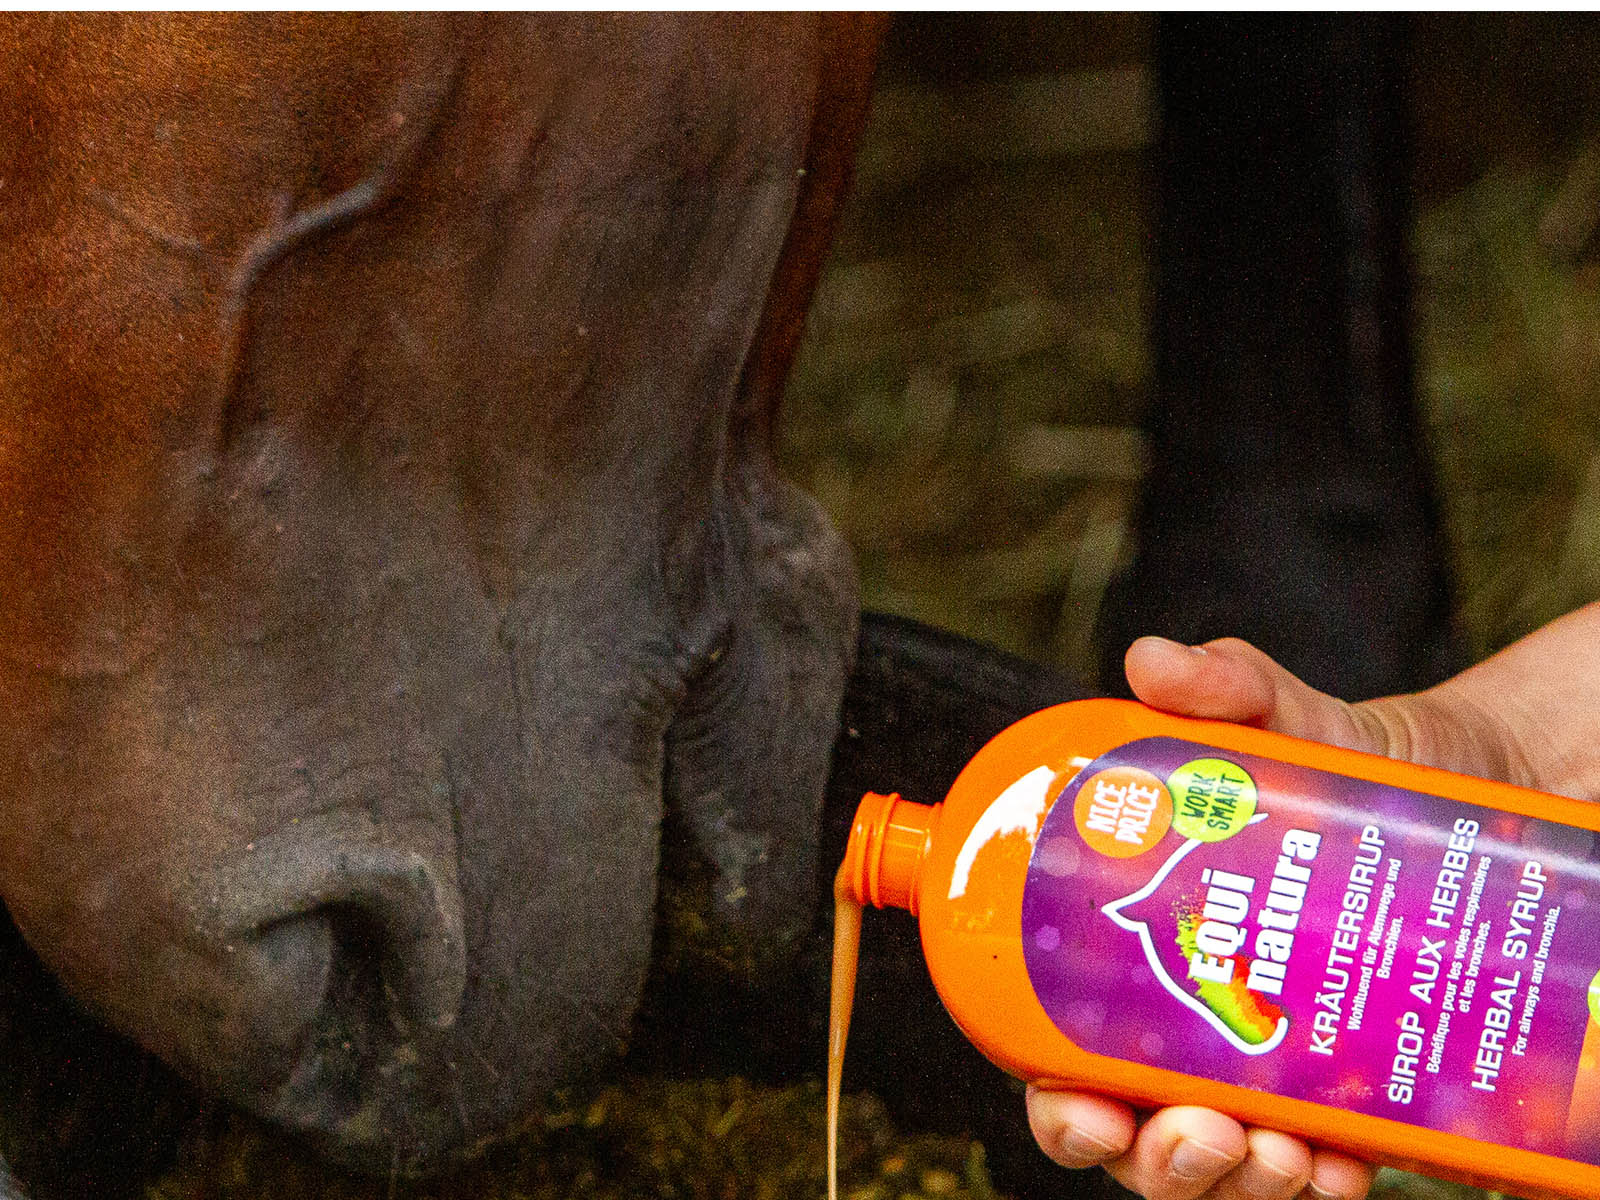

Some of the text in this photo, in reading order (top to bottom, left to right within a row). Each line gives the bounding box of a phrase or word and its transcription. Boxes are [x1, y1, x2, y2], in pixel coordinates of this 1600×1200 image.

[1085, 780, 1127, 833] NICE
[1115, 782, 1160, 844] PRICE
[1181, 772, 1216, 819] WORK
[1207, 773, 1245, 831] SMART
[1246, 829, 1323, 995] natura
[1309, 825, 1386, 1056] KRÄUTERSIRUP
[1347, 858, 1402, 1030] Wohltuend für Atemwege und
[1376, 916, 1404, 979] Bronchien.
[1387, 818, 1480, 1105] SIROP AUX HERBES
[1426, 856, 1492, 1074] Bénéfique pour les voies respiratoires
[1459, 920, 1491, 1013] et les bronches.
[1471, 861, 1547, 1092] HERBAL SYRUP
[1512, 906, 1560, 1056] For airways and bronchia.
